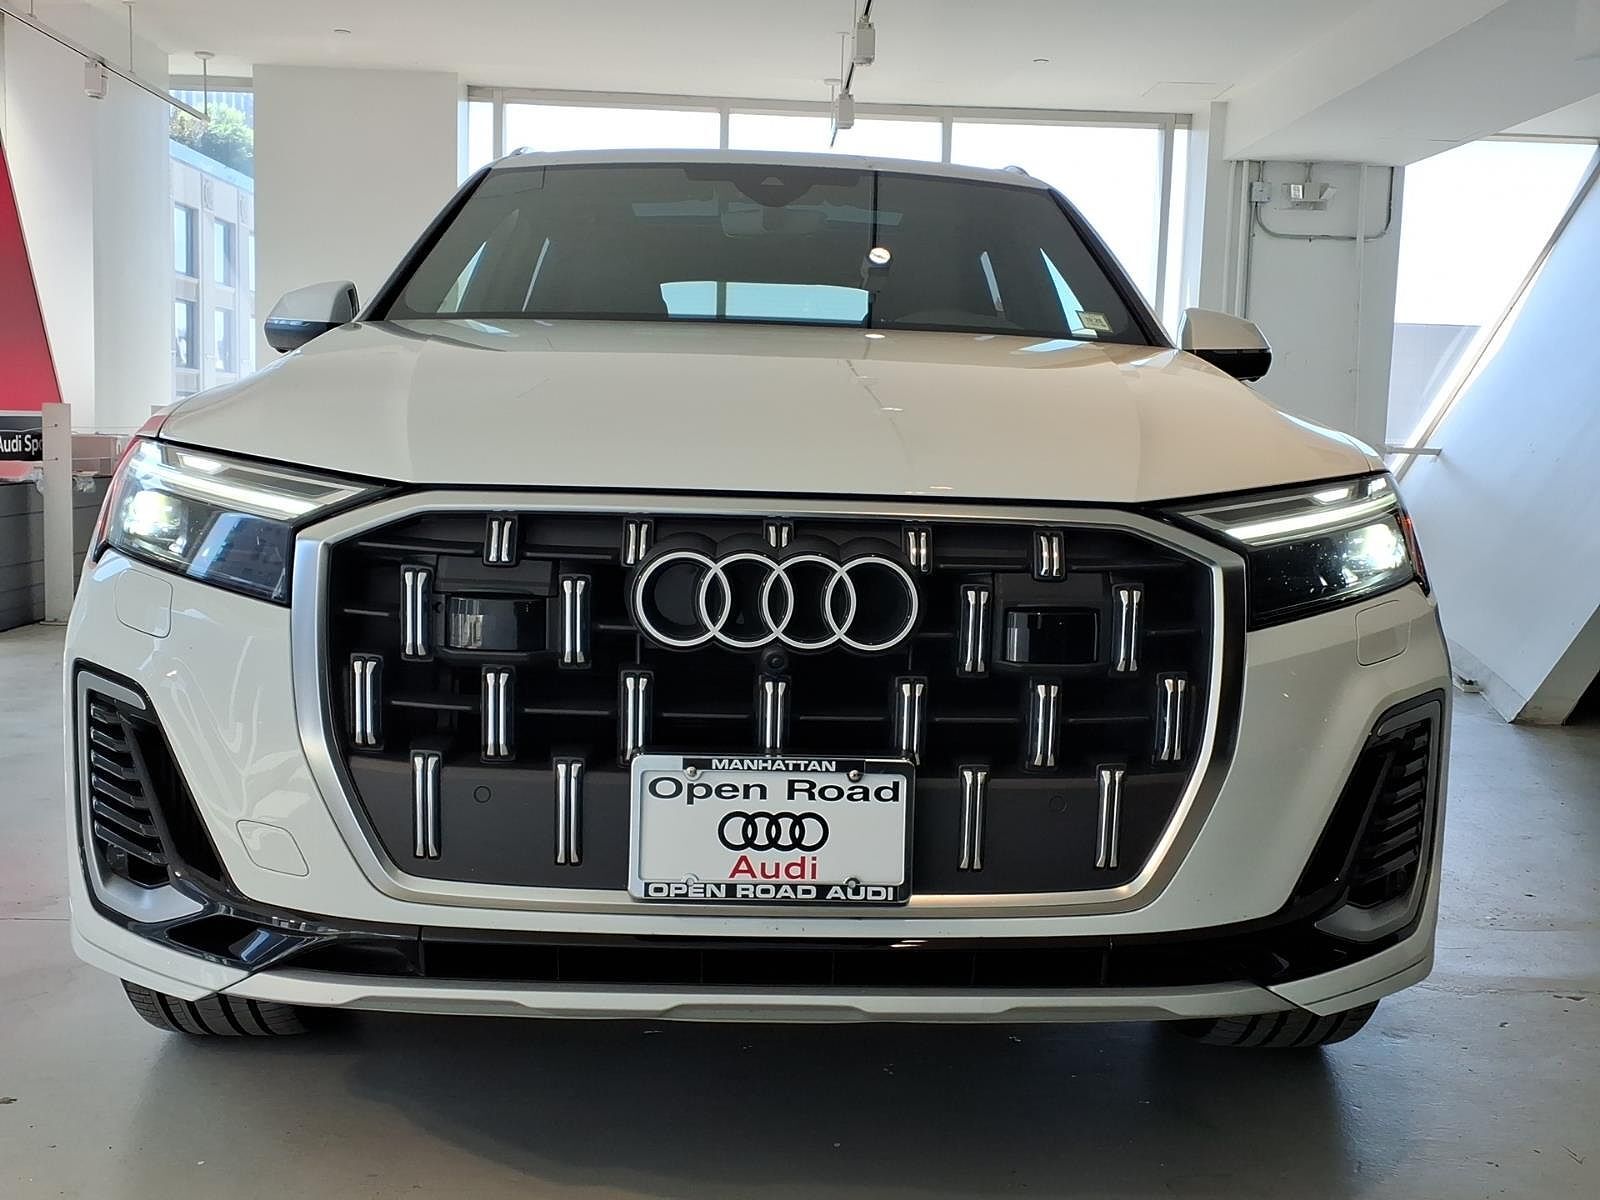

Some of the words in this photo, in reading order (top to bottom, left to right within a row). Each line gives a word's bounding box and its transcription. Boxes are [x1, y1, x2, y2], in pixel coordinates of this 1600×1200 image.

[711, 758, 836, 772] MANHATTAN
[648, 776, 767, 805] Open
[787, 779, 900, 802] Road
[728, 855, 818, 880] Audi
[648, 883, 725, 899] OPEN
[736, 884, 816, 900] ROAD
[829, 886, 894, 901] AUDI
